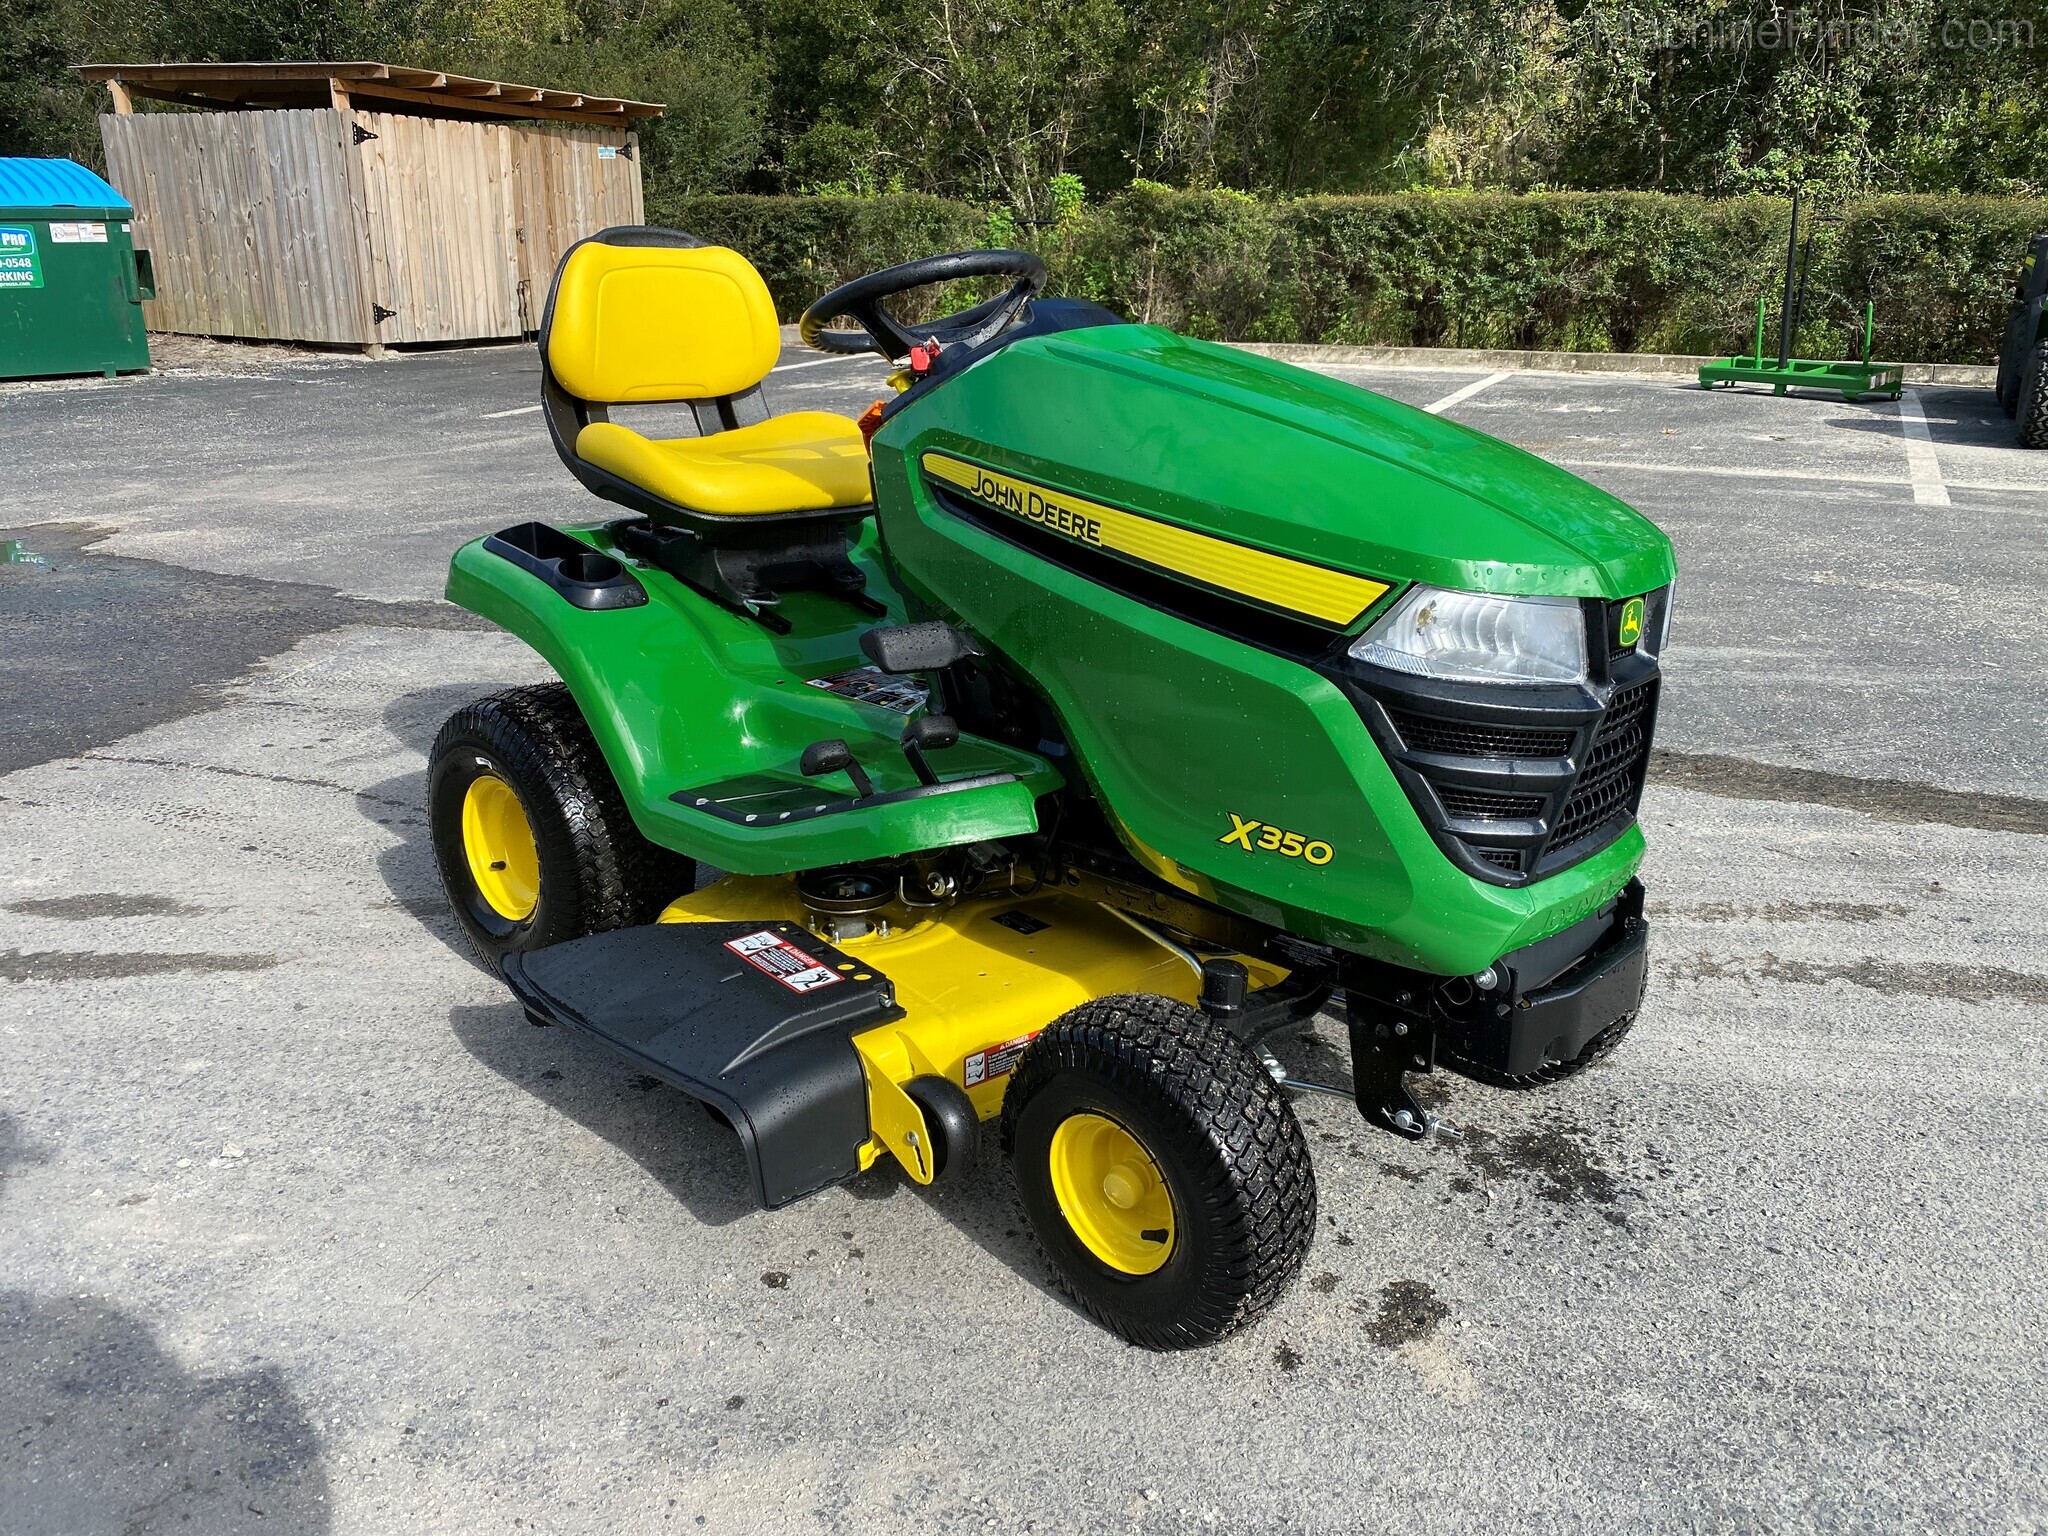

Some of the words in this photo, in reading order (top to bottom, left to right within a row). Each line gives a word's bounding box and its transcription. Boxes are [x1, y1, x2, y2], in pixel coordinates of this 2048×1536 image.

[1, 233, 26, 246] PRO
[971, 470, 1024, 515] JOHN
[1028, 491, 1102, 545] DEERE
[1217, 811, 1336, 866] X350
[789, 947, 818, 967] DANGER
[1005, 1034, 1029, 1048] DANGER
